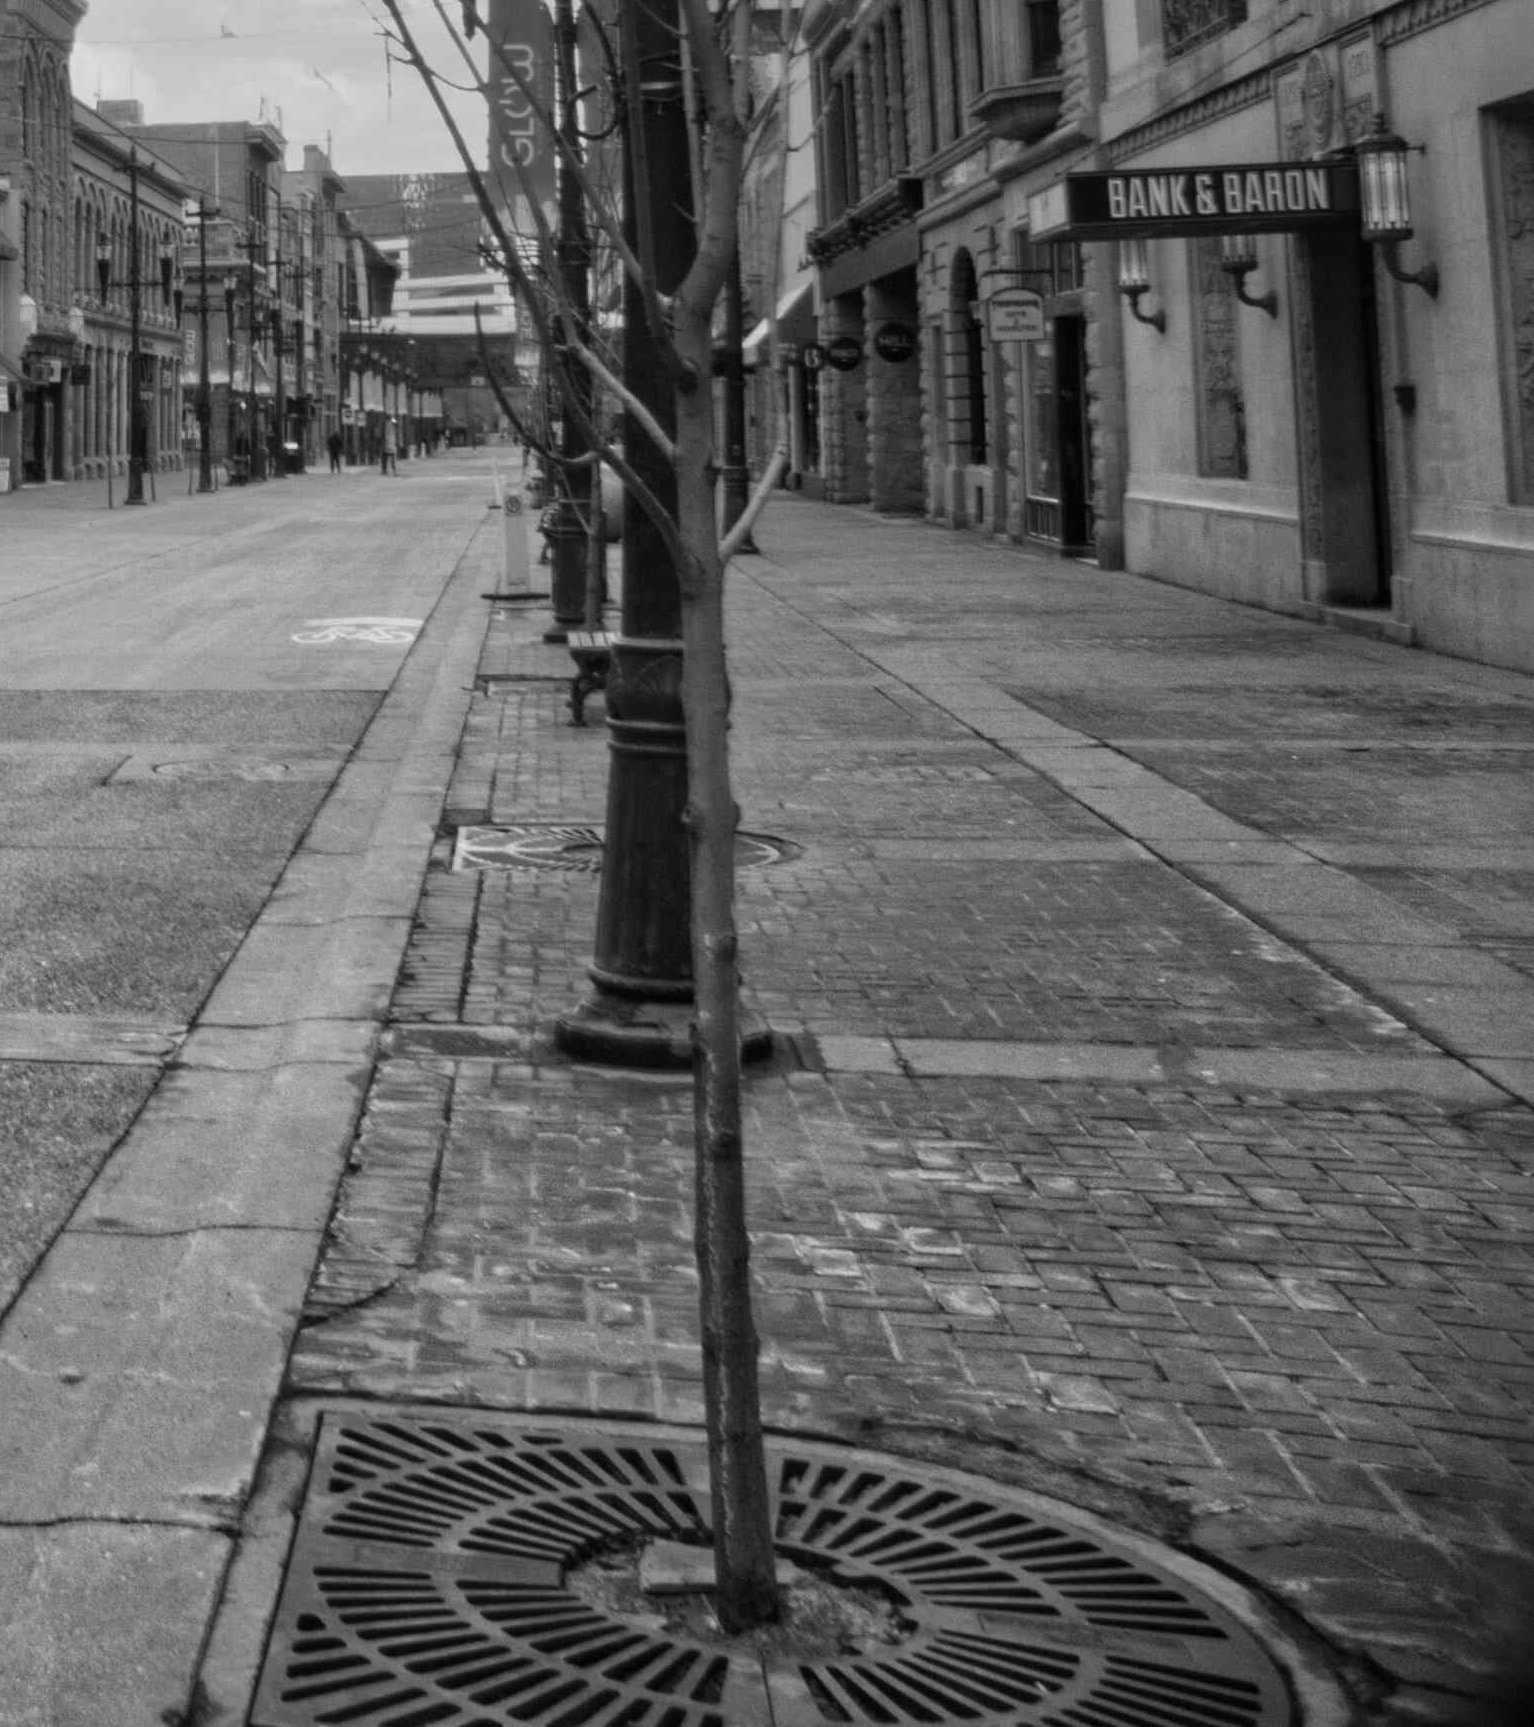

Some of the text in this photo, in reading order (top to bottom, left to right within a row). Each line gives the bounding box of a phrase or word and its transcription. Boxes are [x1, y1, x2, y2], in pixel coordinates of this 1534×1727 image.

[1107, 168, 1330, 219] BANK & BARON
